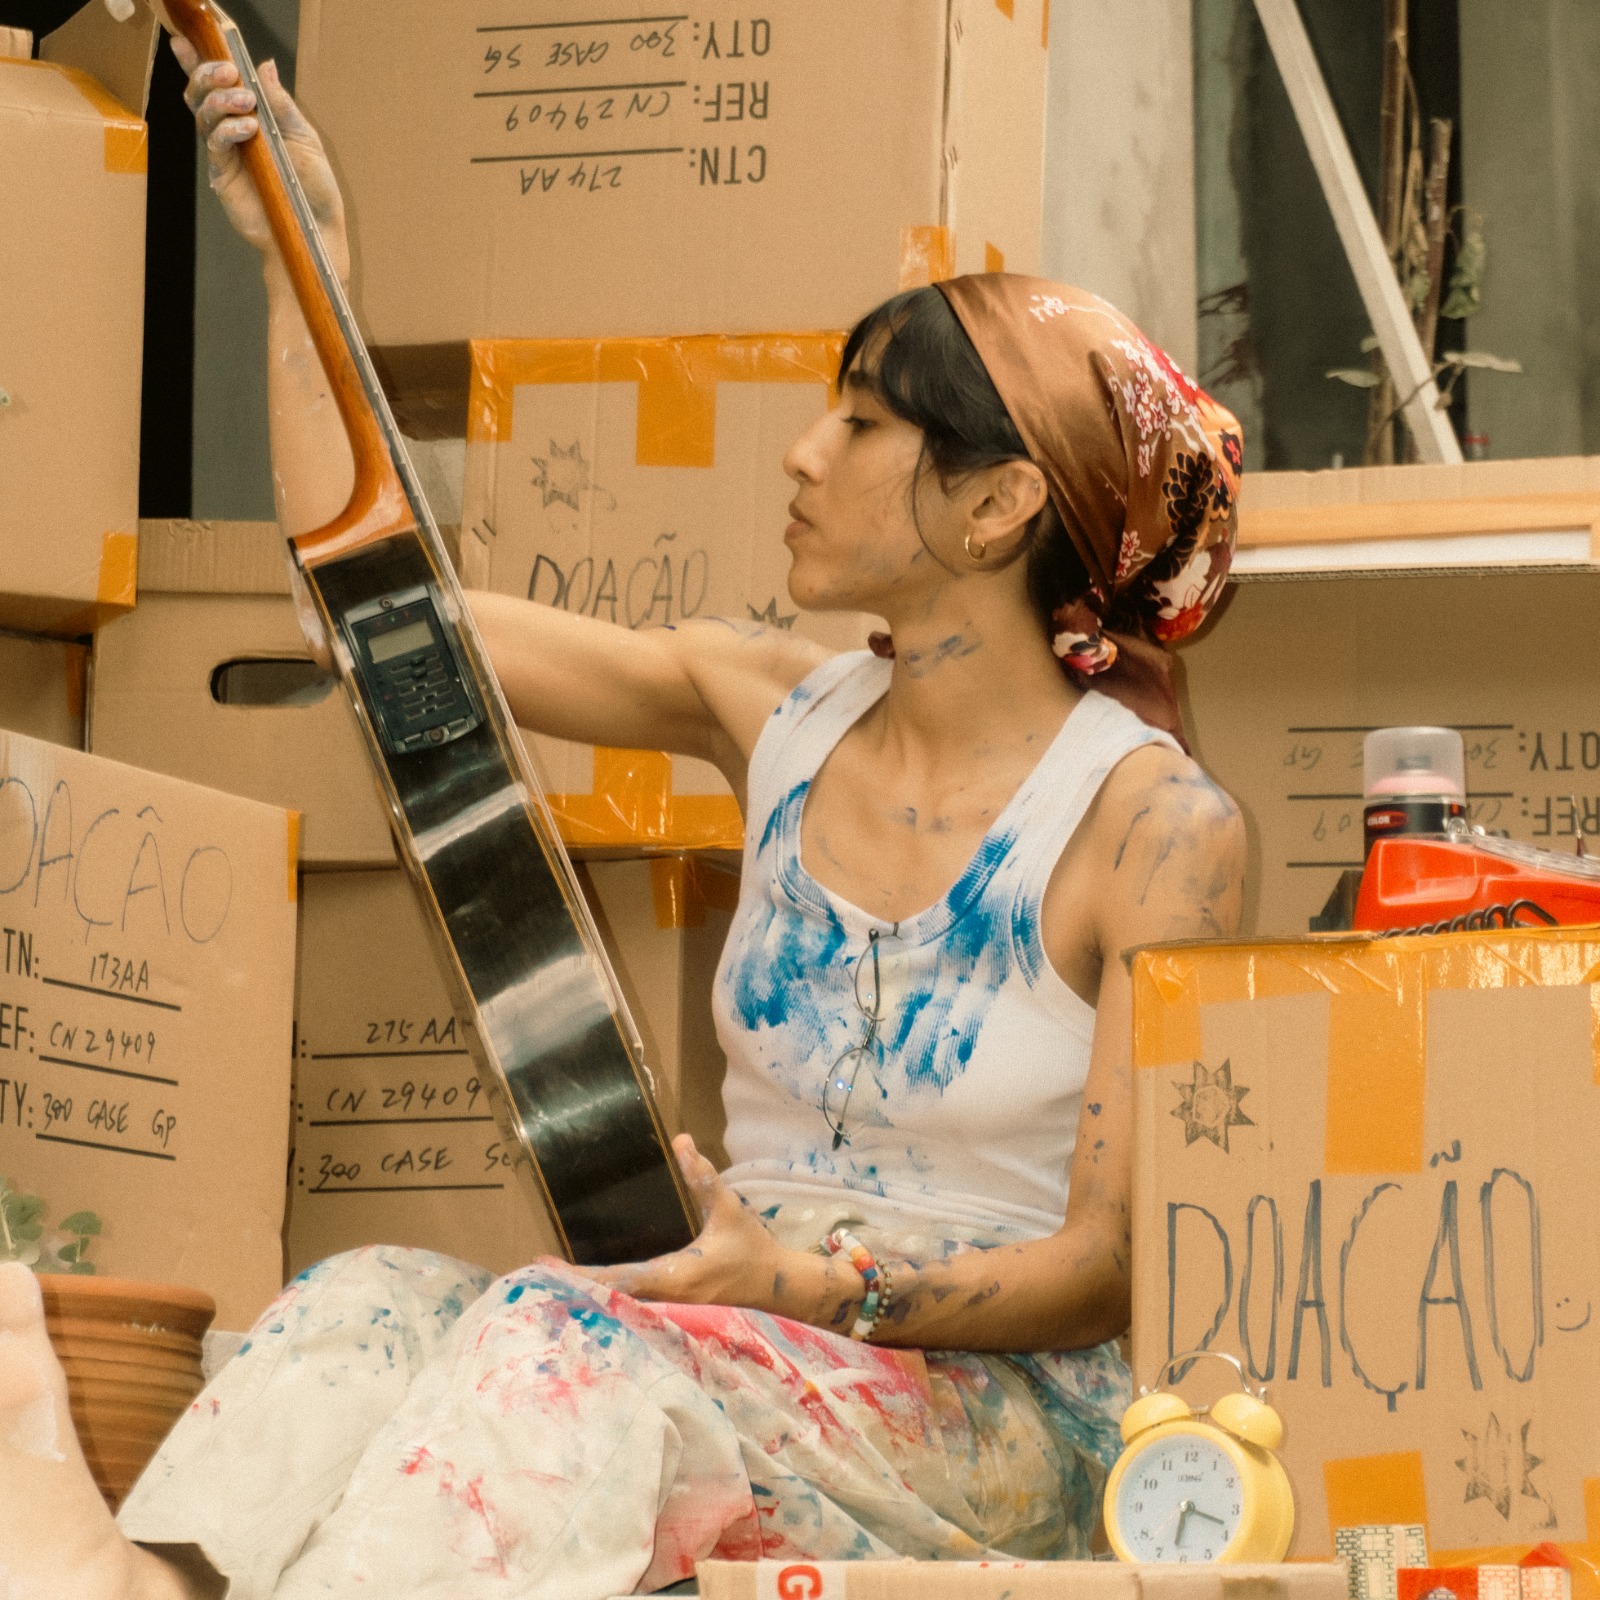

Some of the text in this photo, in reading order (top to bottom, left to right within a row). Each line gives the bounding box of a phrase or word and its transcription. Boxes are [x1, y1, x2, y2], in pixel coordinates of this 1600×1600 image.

[693, 18, 771, 60] QTY:
[545, 41, 609, 67] CASE
[694, 81, 769, 122] REF:
[689, 144, 767, 186] CTN:
[1519, 731, 1600, 771] QTY:
[1522, 797, 1600, 836] REF:
[381, 1147, 453, 1175] CASE
[1167, 1139, 1545, 1412] DOAÇÃO
[1184, 1451, 1199, 1463] 12
[1162, 1459, 1173, 1471] 11
[1143, 1478, 1158, 1490] 10
[1226, 1477, 1235, 1488] 2
[1134, 1502, 1143, 1513] 9
[1232, 1504, 1240, 1516] 3
[1140, 1528, 1149, 1540] 8
[1155, 1546, 1164, 1559] 7
[1204, 1548, 1213, 1560] 5
